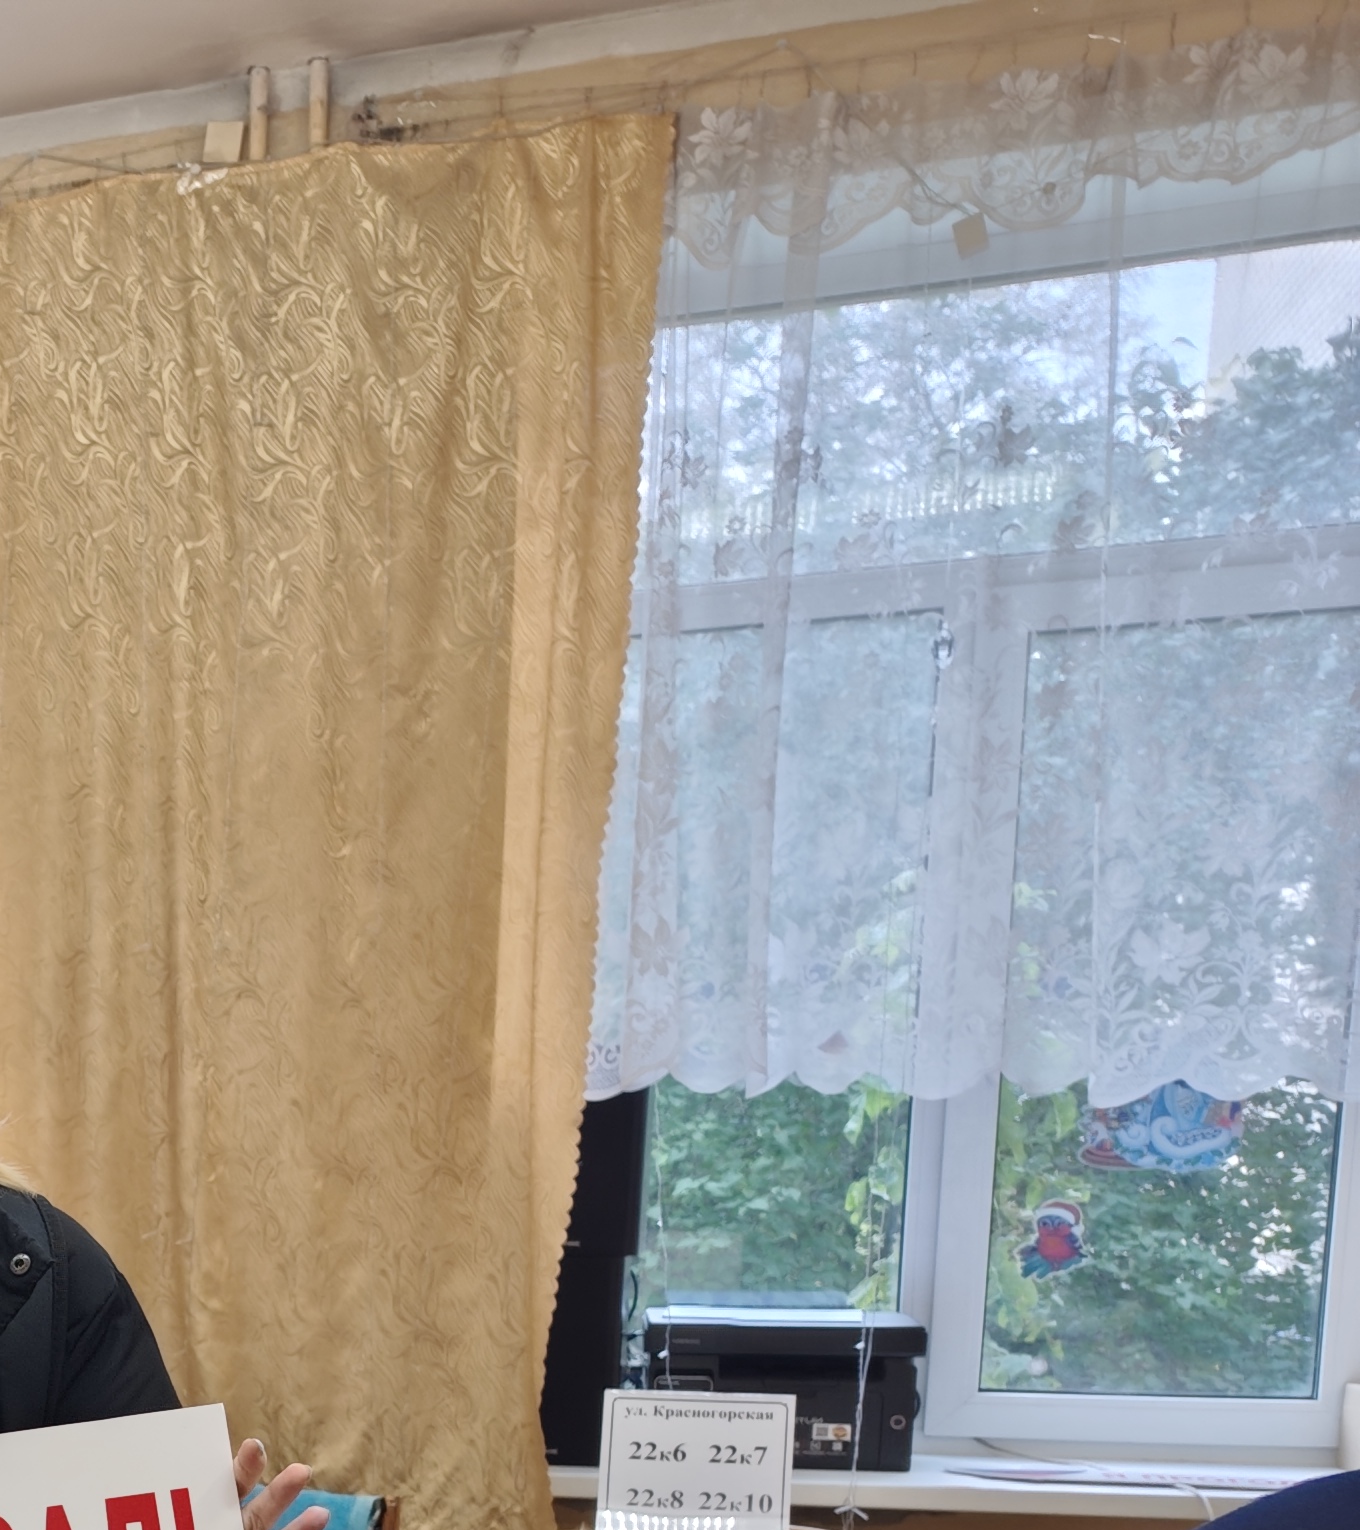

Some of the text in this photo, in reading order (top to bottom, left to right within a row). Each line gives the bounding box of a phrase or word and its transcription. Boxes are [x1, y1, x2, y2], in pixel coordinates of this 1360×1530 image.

[624, 1404, 775, 1423] ул. Красногорская
[628, 1440, 769, 1466] 22к6 22к7
[626, 1488, 774, 1514] 22к8 22к10
